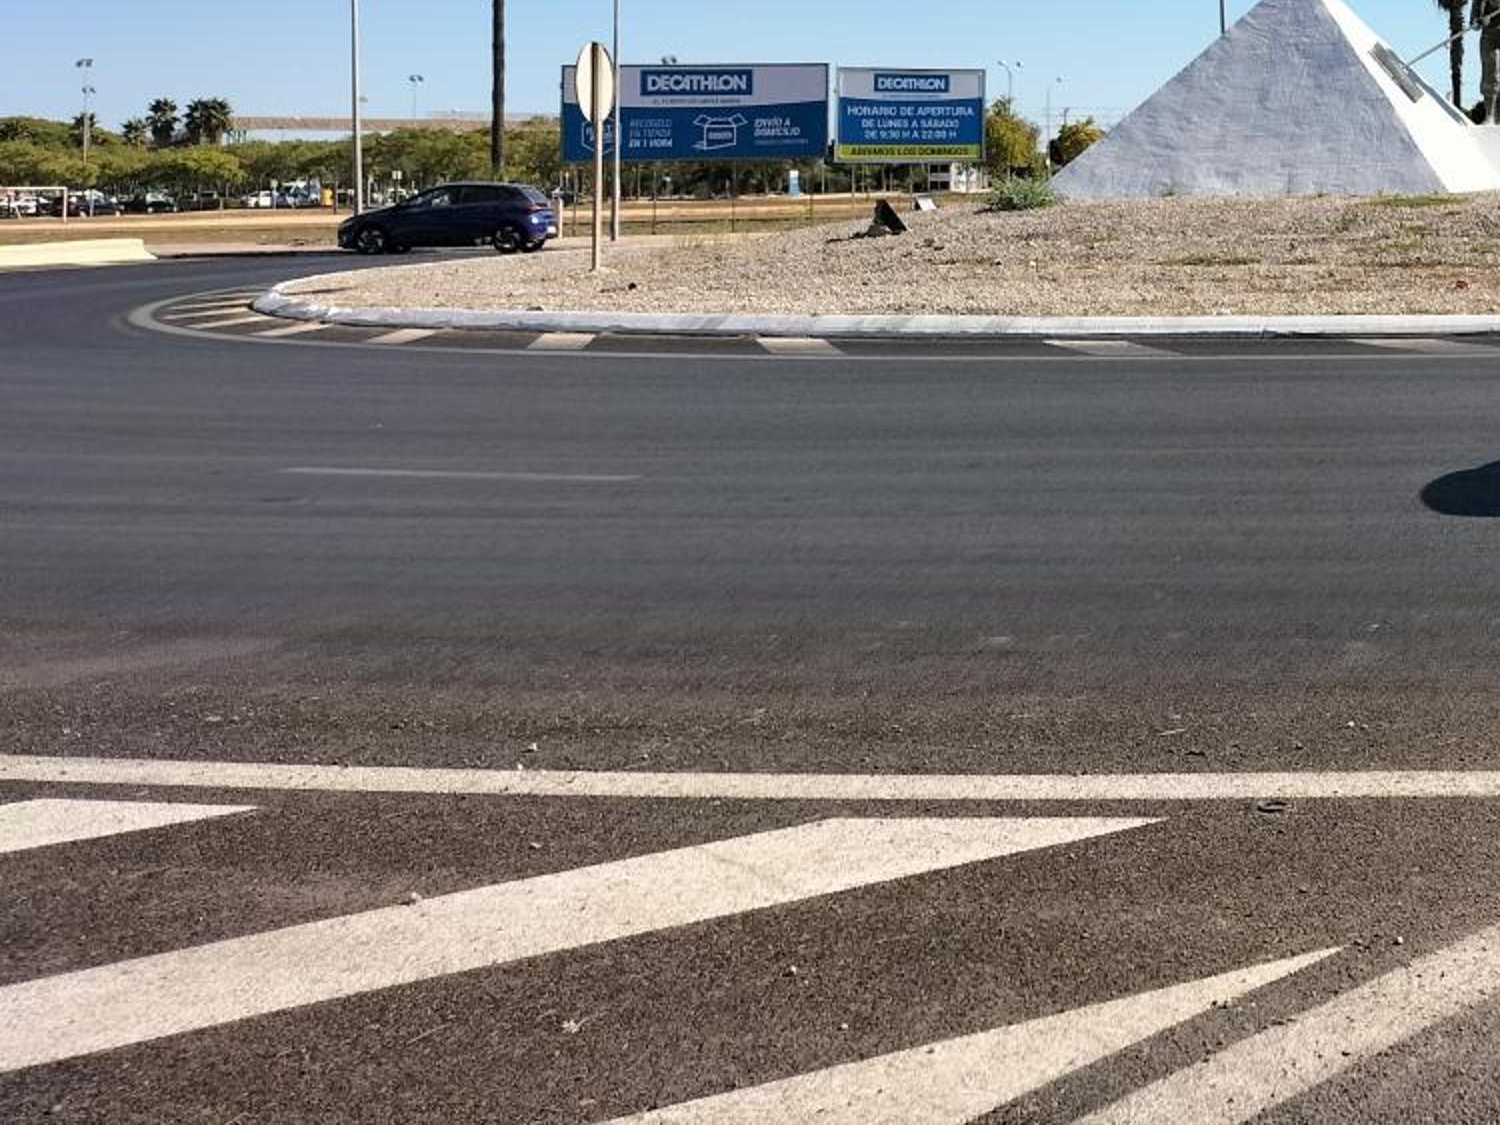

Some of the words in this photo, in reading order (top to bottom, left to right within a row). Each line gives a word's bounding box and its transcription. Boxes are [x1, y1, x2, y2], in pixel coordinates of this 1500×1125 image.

[647, 74, 747, 92] DECATHLON
[877, 77, 946, 90] DECATHLON
[847, 106, 897, 116] HORARIO
[899, 106, 915, 116] DE
[917, 106, 975, 116] APERTURA
[877, 119, 909, 128] LUNES
[911, 119, 919, 128] A
